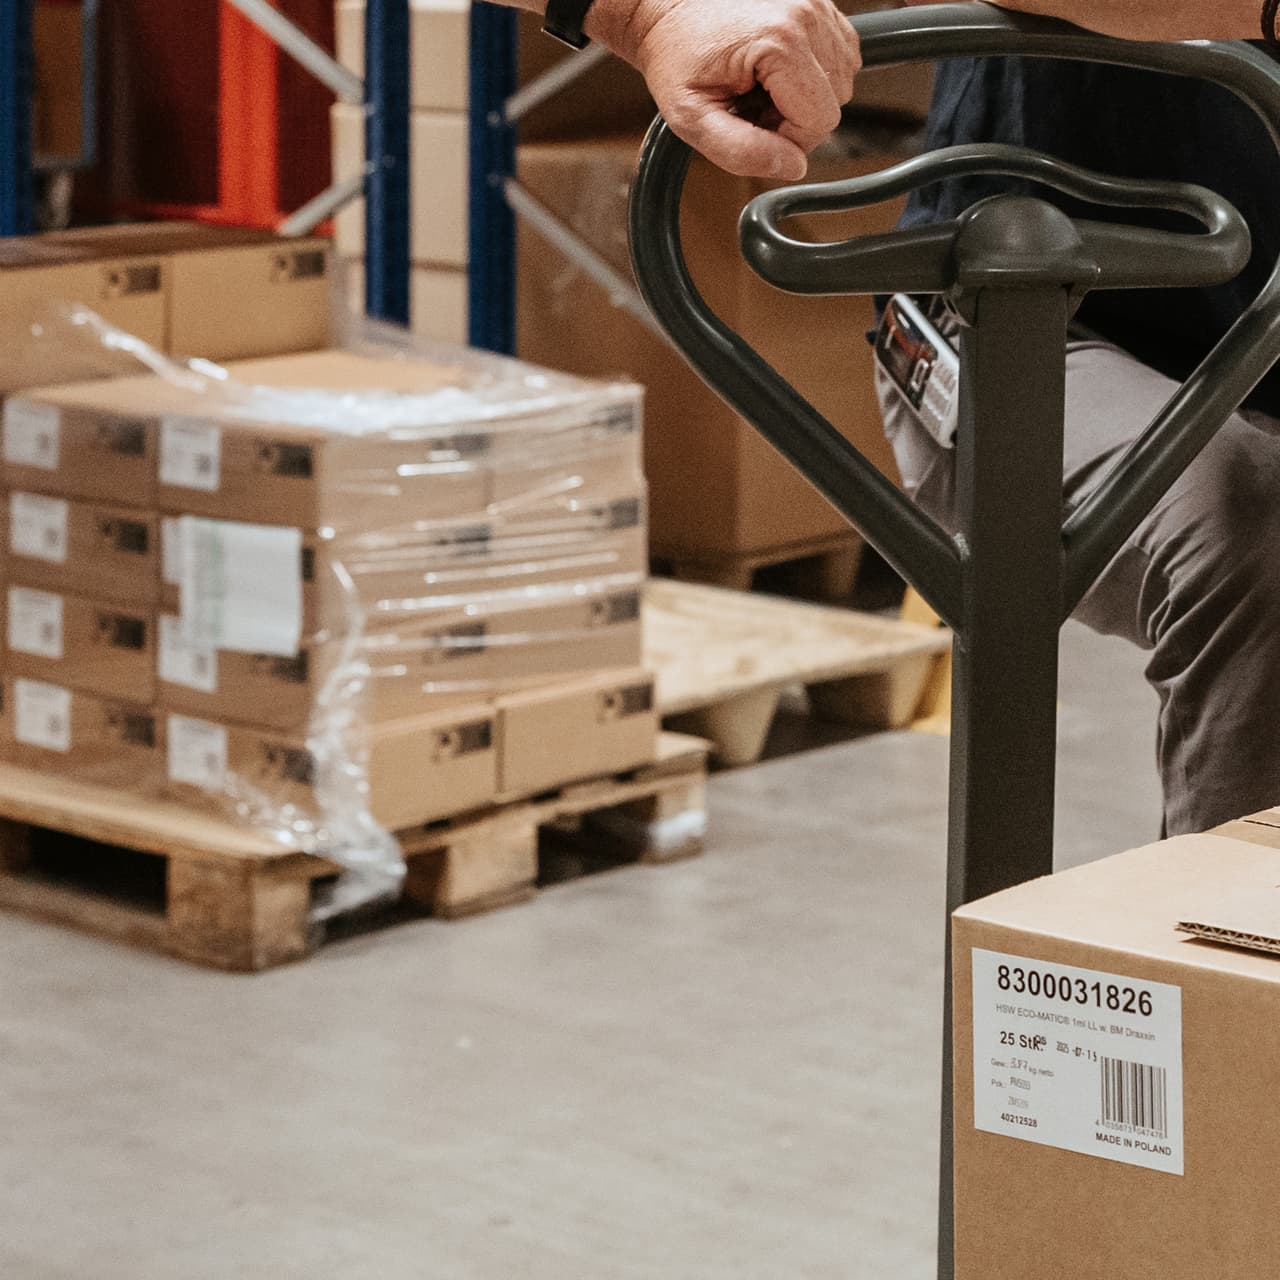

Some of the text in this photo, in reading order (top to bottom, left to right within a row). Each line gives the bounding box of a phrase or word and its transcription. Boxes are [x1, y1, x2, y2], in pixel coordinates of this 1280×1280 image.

[997, 964, 1153, 1016] 8300031826
[1000, 1031, 1015, 1046] 25
[1095, 1132, 1172, 1156] MADE IN POLAND
